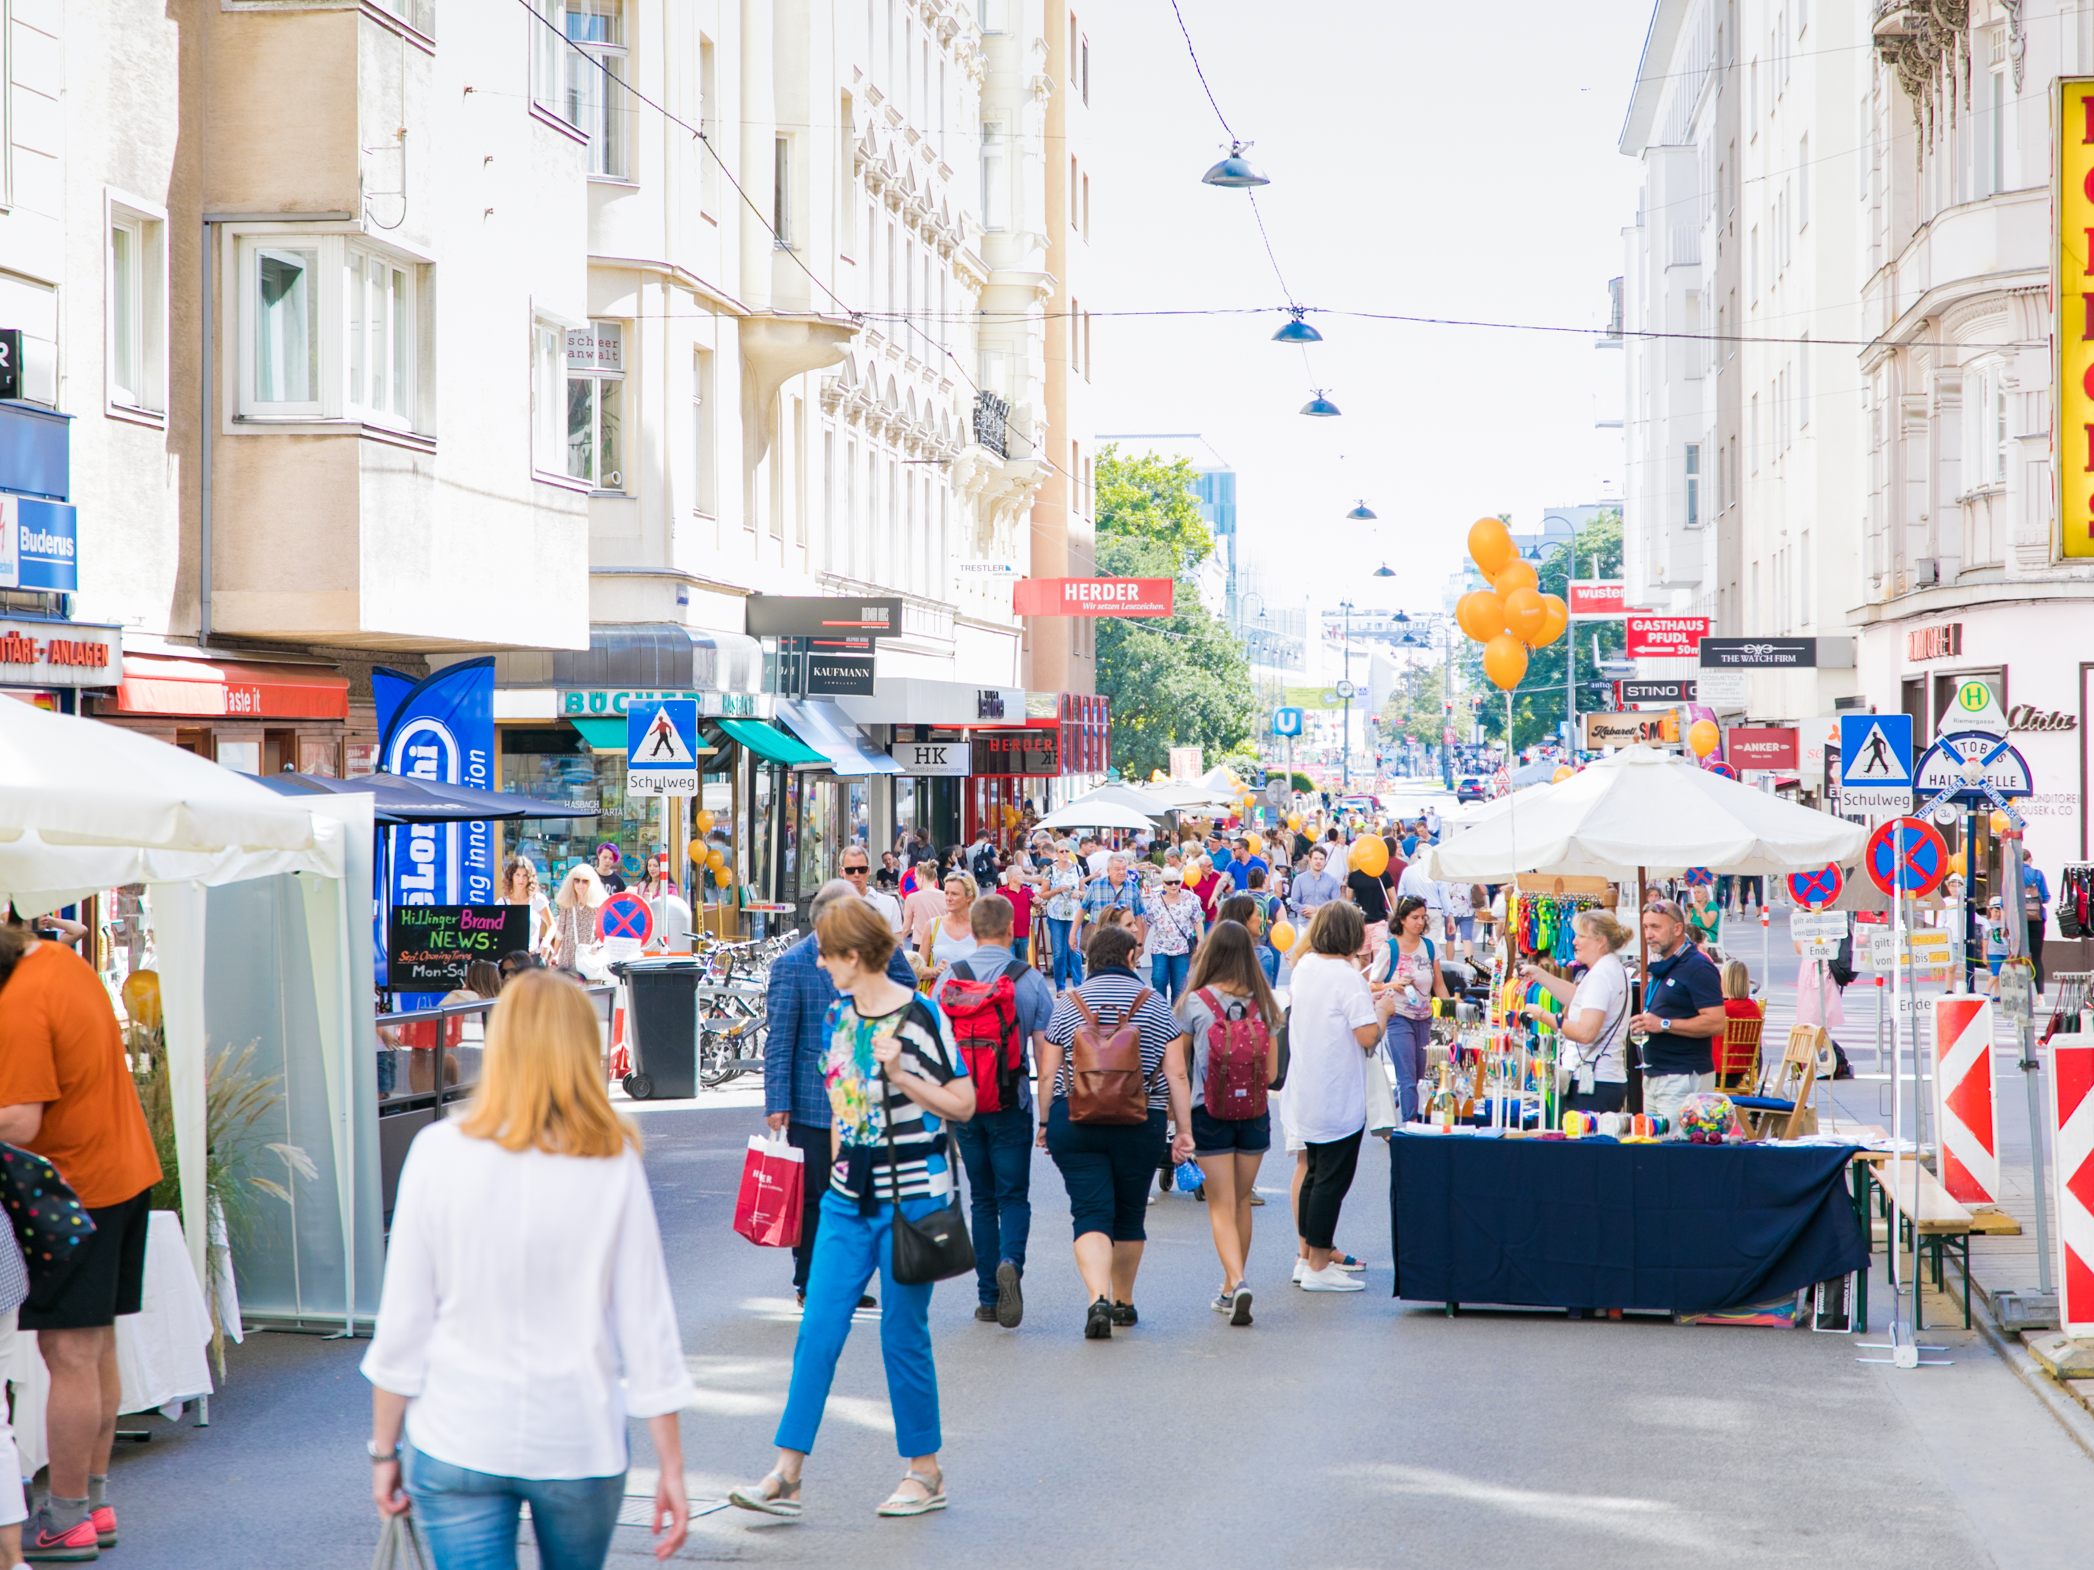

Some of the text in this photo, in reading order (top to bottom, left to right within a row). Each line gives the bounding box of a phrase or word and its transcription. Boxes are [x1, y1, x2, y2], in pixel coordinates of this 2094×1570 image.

[568, 336, 618, 348] scheer
[568, 350, 618, 361] anwalt
[20, 525, 74, 558] Buderus
[960, 564, 1005, 572] TRESTLER
[1065, 583, 1139, 600] HERDER
[1083, 602, 1165, 611] Wir setzen Lesezeichen.
[1632, 620, 1705, 631] GASTHAUS
[1648, 632, 1689, 643] PFUDL
[48, 639, 109, 667] ANLAGEN
[1721, 654, 1796, 663] THE WATCH FIRM
[813, 666, 870, 678] KAUFMANN
[1627, 685, 1679, 697] STINO
[1966, 687, 1982, 706] H
[223, 685, 261, 712] Taste it
[1277, 712, 1297, 732] U
[989, 738, 1052, 752] HERDER
[1743, 742, 1780, 752] ANKER
[914, 746, 947, 765] HK
[630, 775, 695, 791] Schulweg
[1844, 792, 1910, 808] Schulweg
[2058, 805, 2073, 816] CO
[460, 908, 506, 930] Brand
[429, 931, 498, 951] NEWS:
[1874, 939, 1890, 950] gilt
[1809, 946, 1830, 956] Ende
[1875, 957, 1892, 966] von
[1915, 952, 1928, 962] bis
